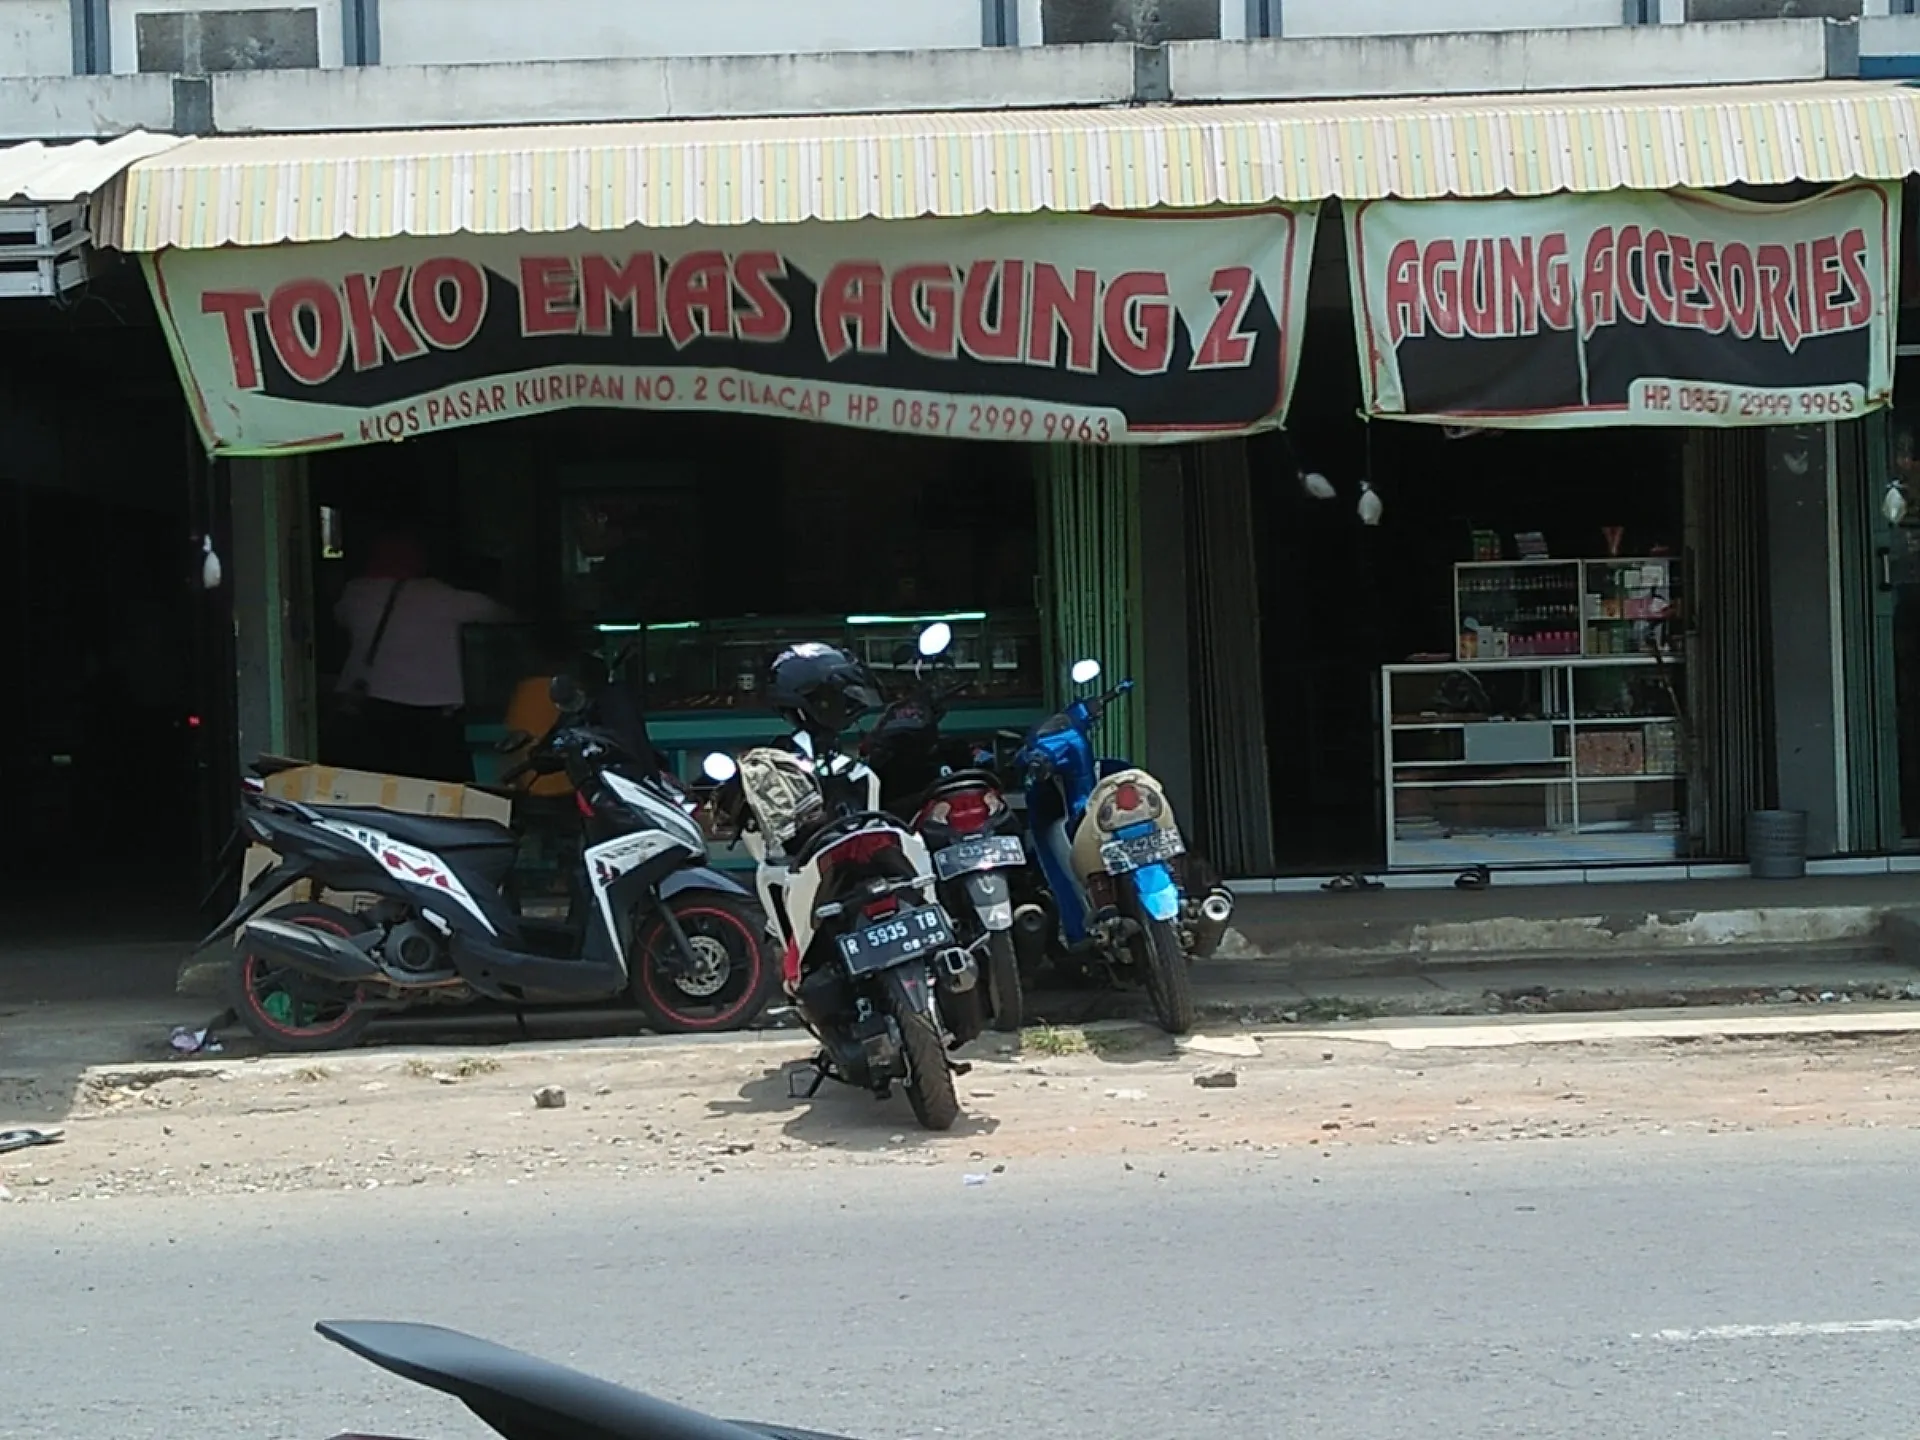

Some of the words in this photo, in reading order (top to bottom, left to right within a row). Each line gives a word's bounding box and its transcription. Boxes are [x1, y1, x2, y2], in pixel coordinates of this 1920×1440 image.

[202, 256, 487, 391] TOKO
[519, 250, 791, 349] EMAS
[817, 259, 1174, 374] AGUNG
[1386, 233, 1573, 346] AGUNG
[1583, 224, 1872, 352] ACCESORIES
[359, 404, 420, 441] KIOS
[426, 385, 506, 426] PASAR
[515, 374, 624, 406] KURIPAN
[635, 375, 683, 402] NO.
[694, 375, 708, 400] 2
[718, 377, 830, 418] CILACAP
[847, 393, 881, 423] HP.
[892, 398, 958, 432] 0857
[969, 403, 1034, 435] 2999
[1043, 413, 1110, 442] 9963
[1643, 384, 1671, 410] HP.
[1679, 387, 1731, 414] 0857
[1738, 392, 1792, 416] 2999
[1800, 390, 1854, 415] 9963
[847, 938, 859, 954] R
[867, 921, 908, 946] 5935
[915, 911, 938, 930] TB
